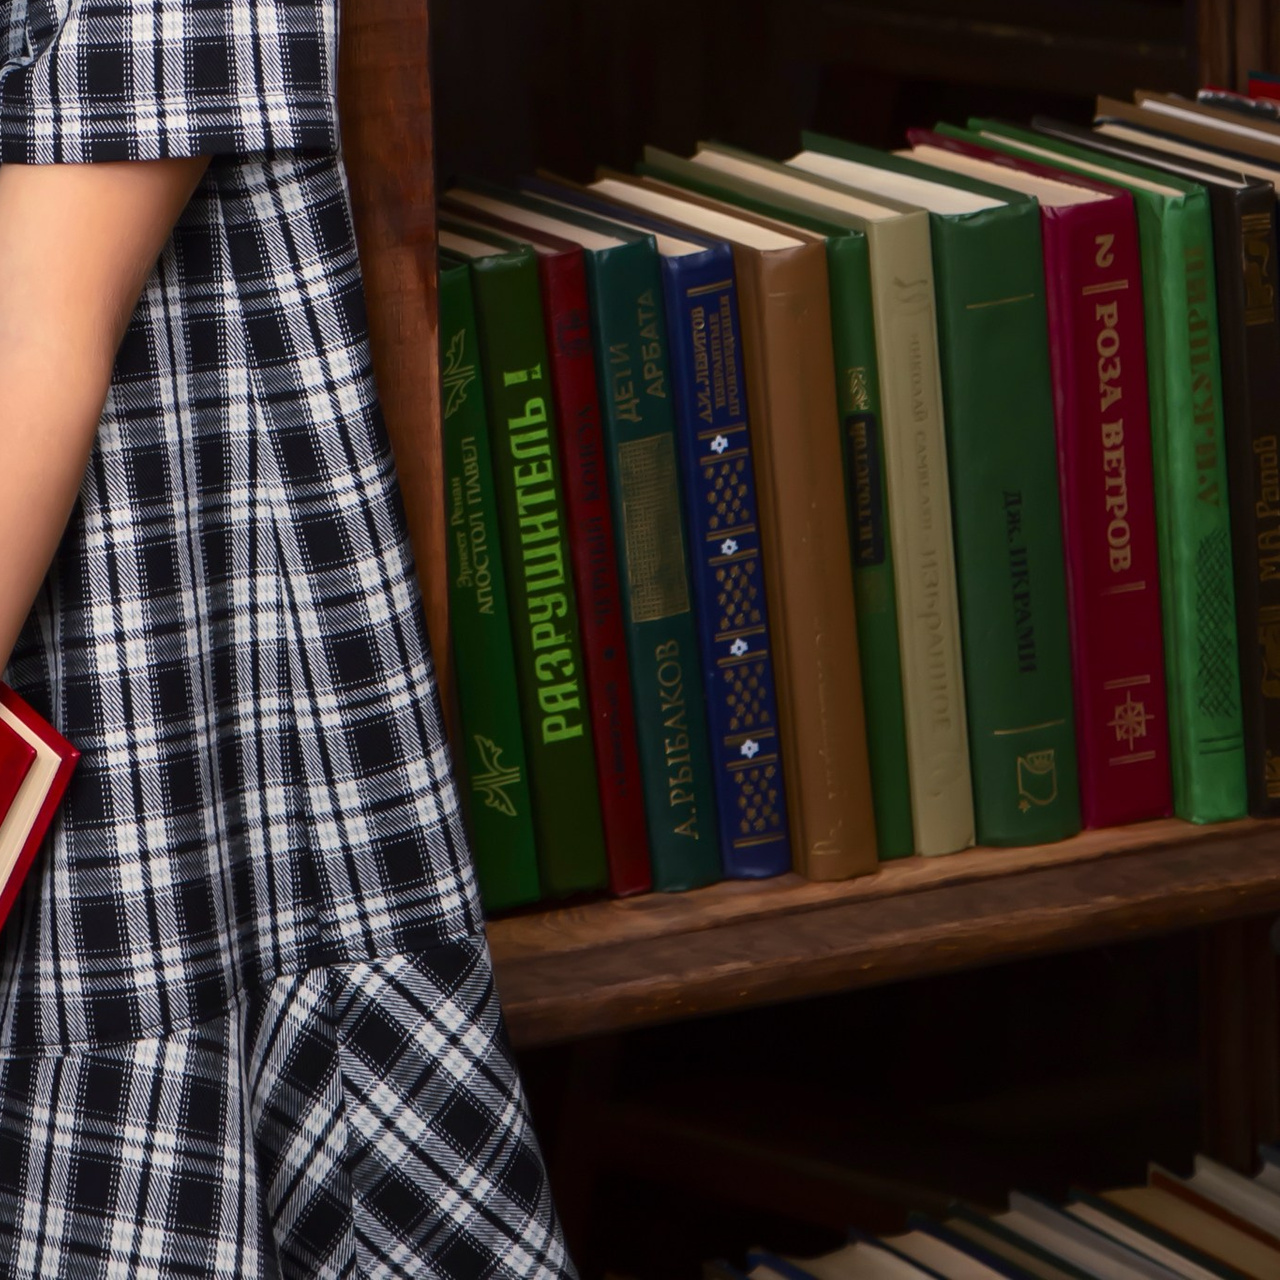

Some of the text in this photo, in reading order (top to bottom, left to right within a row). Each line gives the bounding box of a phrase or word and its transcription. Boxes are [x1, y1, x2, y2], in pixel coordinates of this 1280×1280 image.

[1094, 233, 1115, 268] 2
[609, 343, 643, 423] ДЕТИ
[637, 288, 666, 398] АРБАТА
[709, 312, 726, 409] ИЗБРАННЫЕ
[720, 296, 740, 416] ПРОИЗВЕДЕНИЯ
[1095, 300, 1132, 573] РОЗА ВЕТРОВ
[451, 477, 473, 587] Эрнест Ренан
[461, 436, 494, 614] АПОСТОЛ ПАВЕЛ
[507, 396, 584, 744] РАЗРУШИТЕЛЬ
[655, 638, 699, 841] А.РЫБАКОВ
